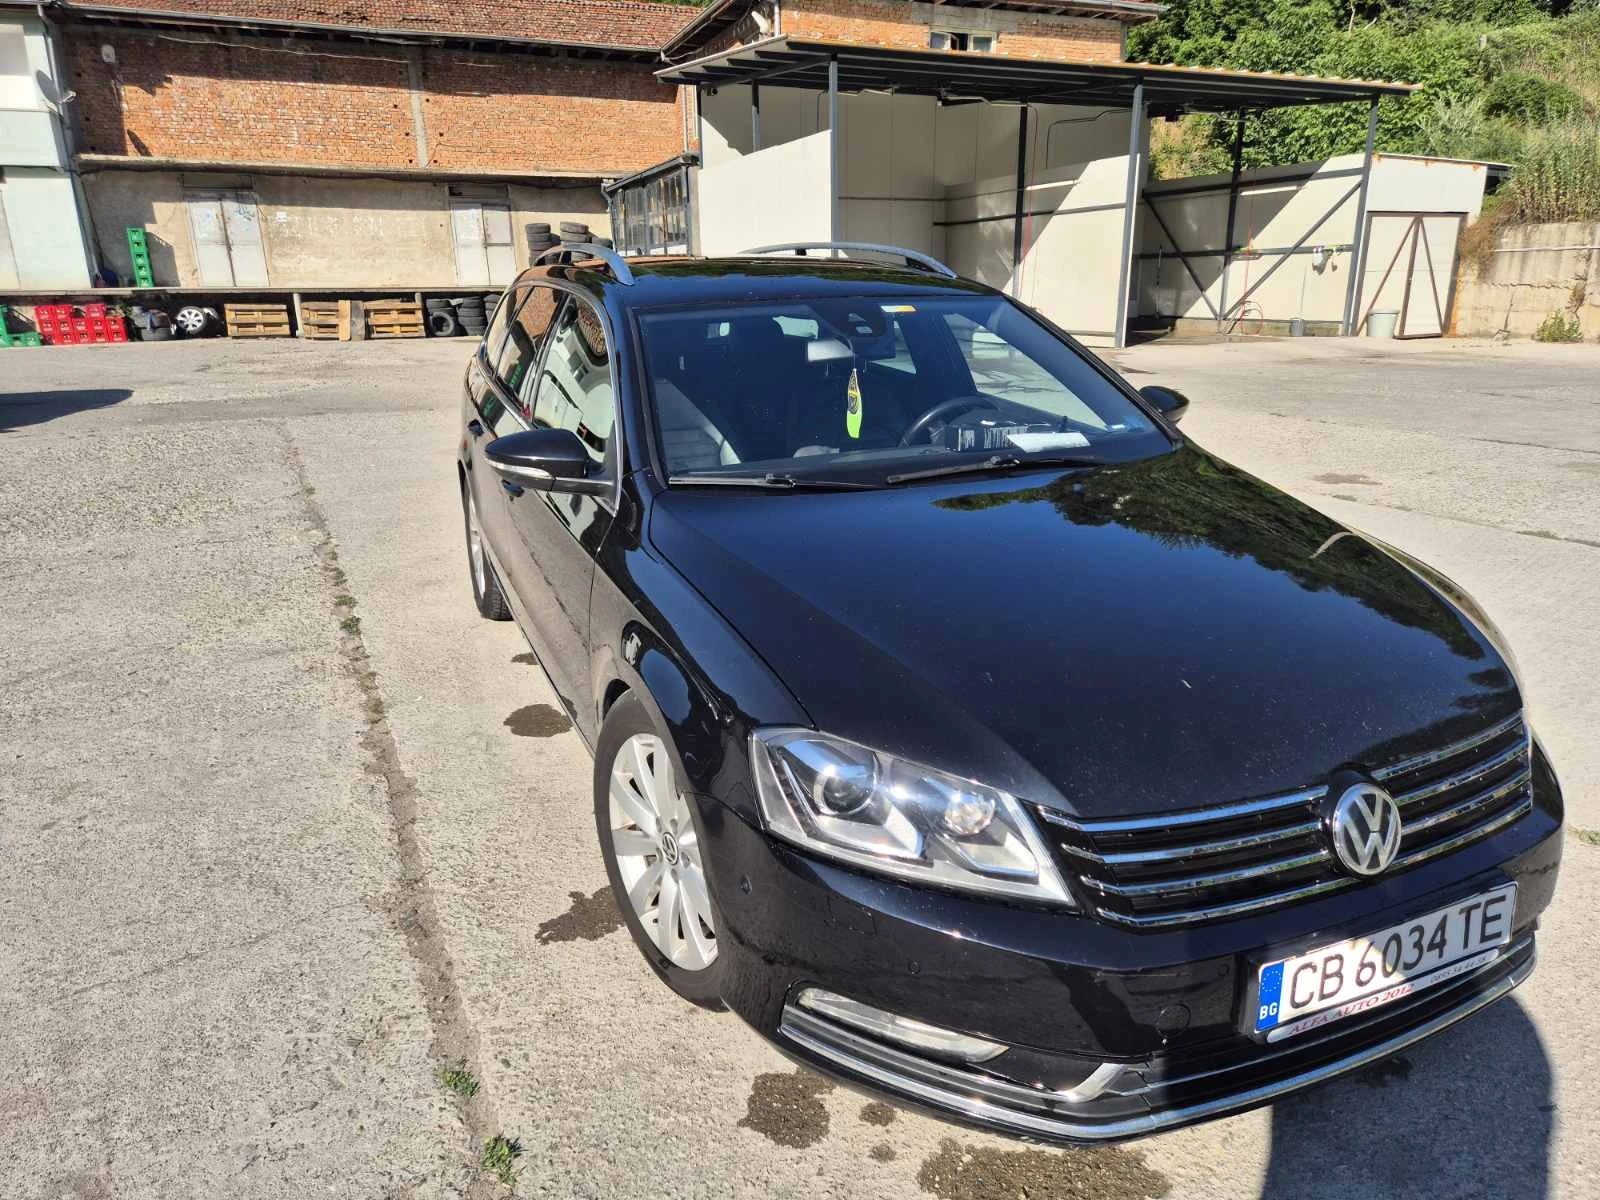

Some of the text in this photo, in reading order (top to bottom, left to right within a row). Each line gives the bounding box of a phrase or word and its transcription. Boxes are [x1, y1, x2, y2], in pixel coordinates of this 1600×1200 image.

[1289, 953, 1344, 1009] CB
[1355, 914, 1449, 987] 6034
[1459, 895, 1507, 950] TE
[1259, 1002, 1278, 1020] BG
[1289, 983, 1415, 1035] ALFA AUTO 2012
